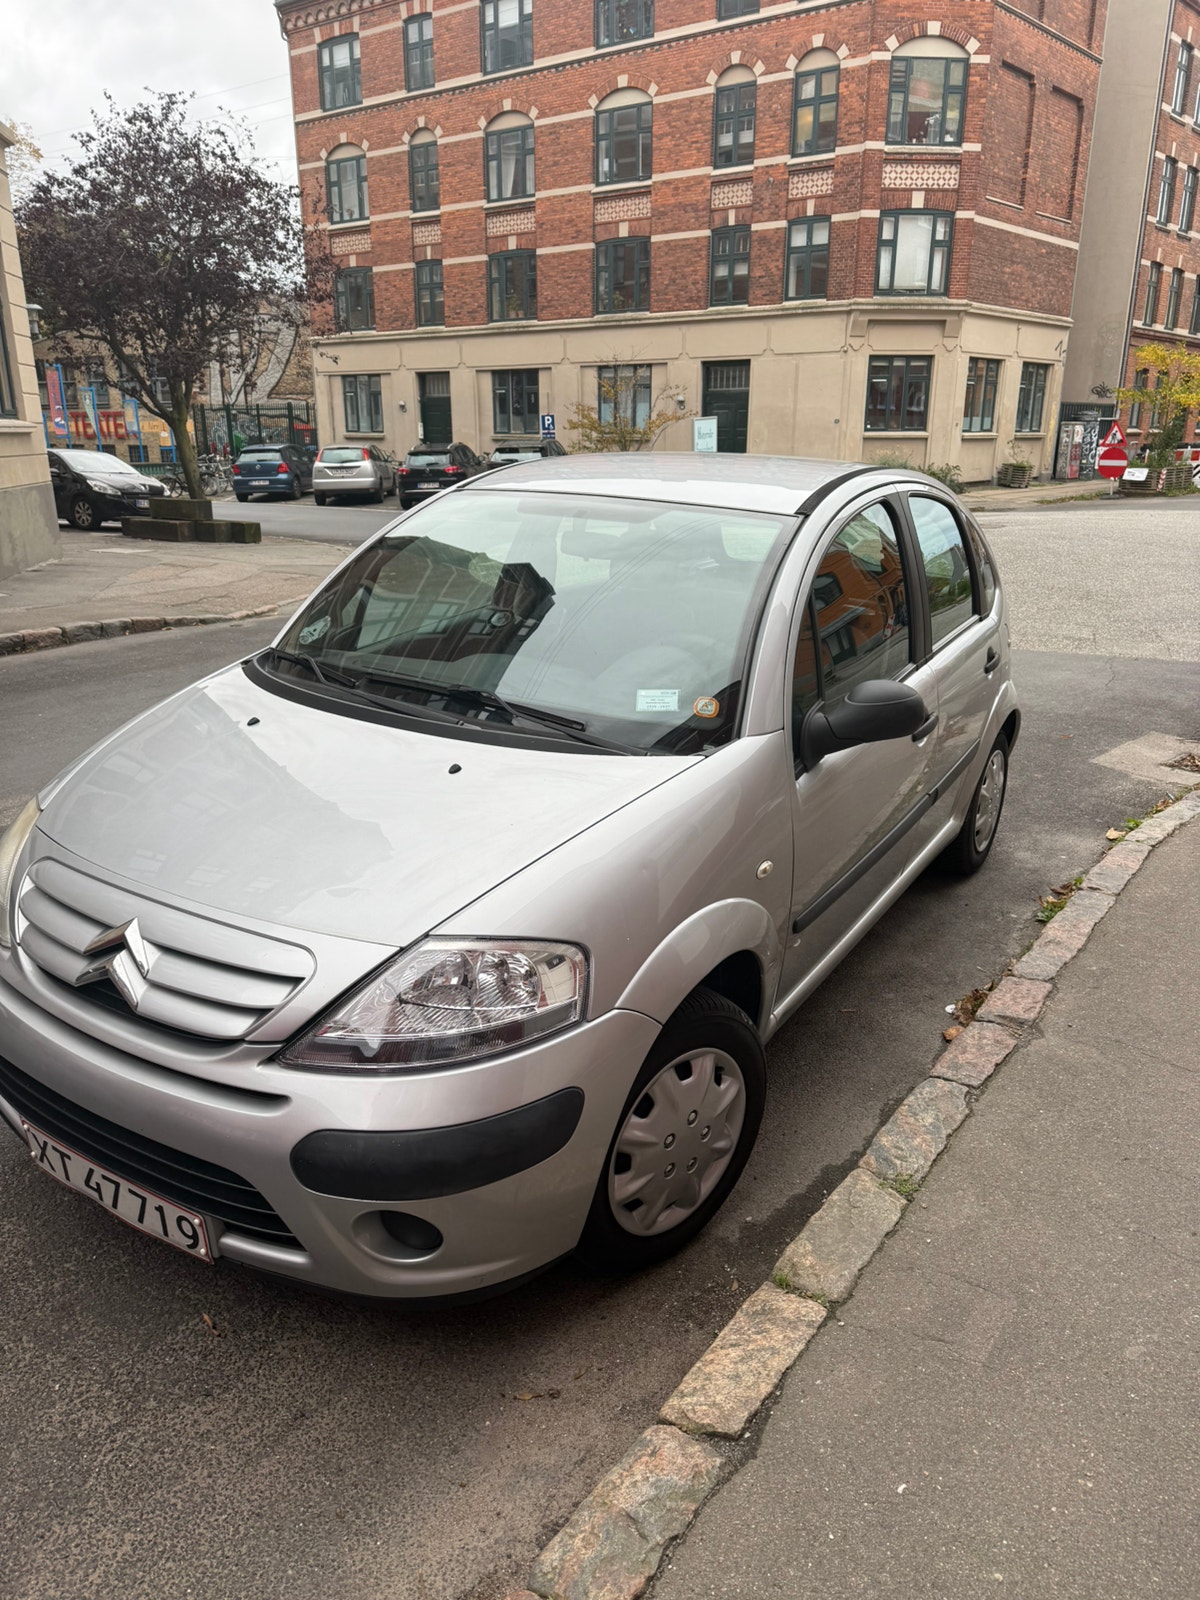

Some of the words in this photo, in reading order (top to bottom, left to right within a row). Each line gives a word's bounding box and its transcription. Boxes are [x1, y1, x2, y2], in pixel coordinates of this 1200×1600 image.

[544, 415, 553, 428] P
[31, 1131, 72, 1182] XT
[84, 1167, 199, 1250] 47719
